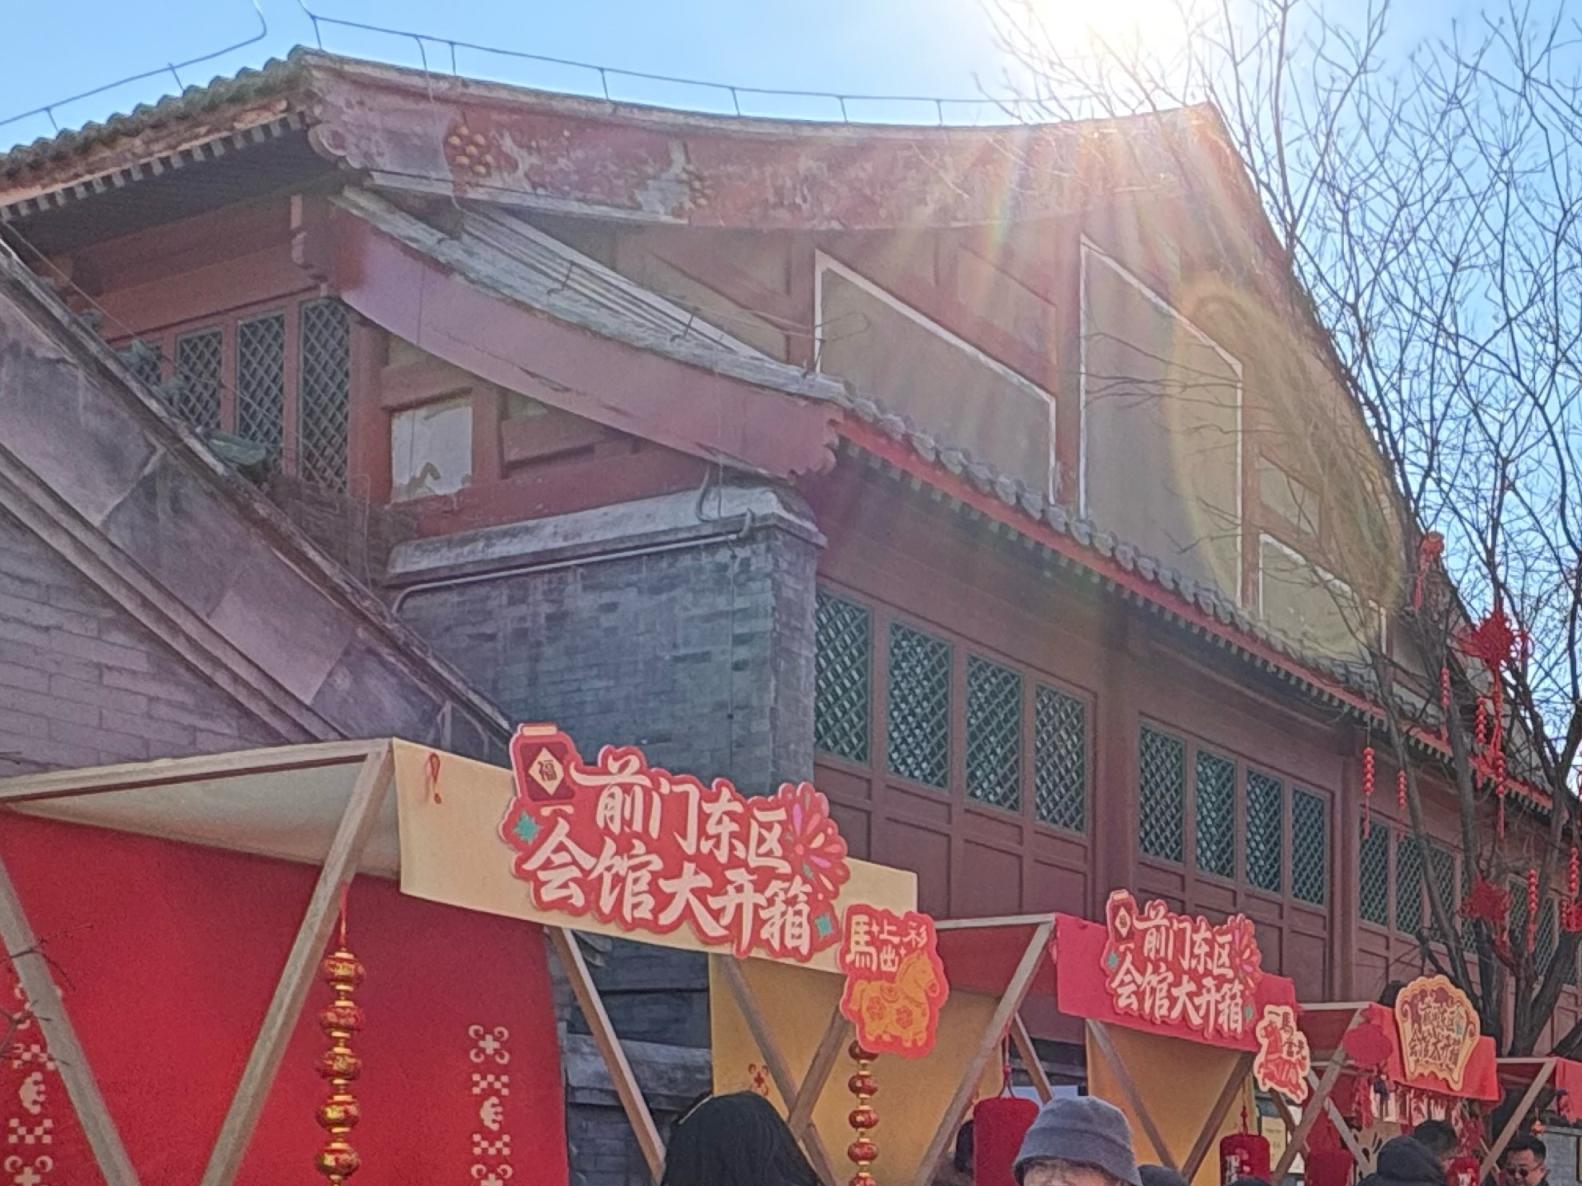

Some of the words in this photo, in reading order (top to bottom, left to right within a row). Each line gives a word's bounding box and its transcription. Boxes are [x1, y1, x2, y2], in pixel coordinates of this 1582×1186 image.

[571, 752, 791, 874] 前门东区
[522, 819, 812, 955] 会馆大开箱
[1134, 906, 1234, 977] 前门东区
[1111, 952, 1243, 1035] 会馆大开箱
